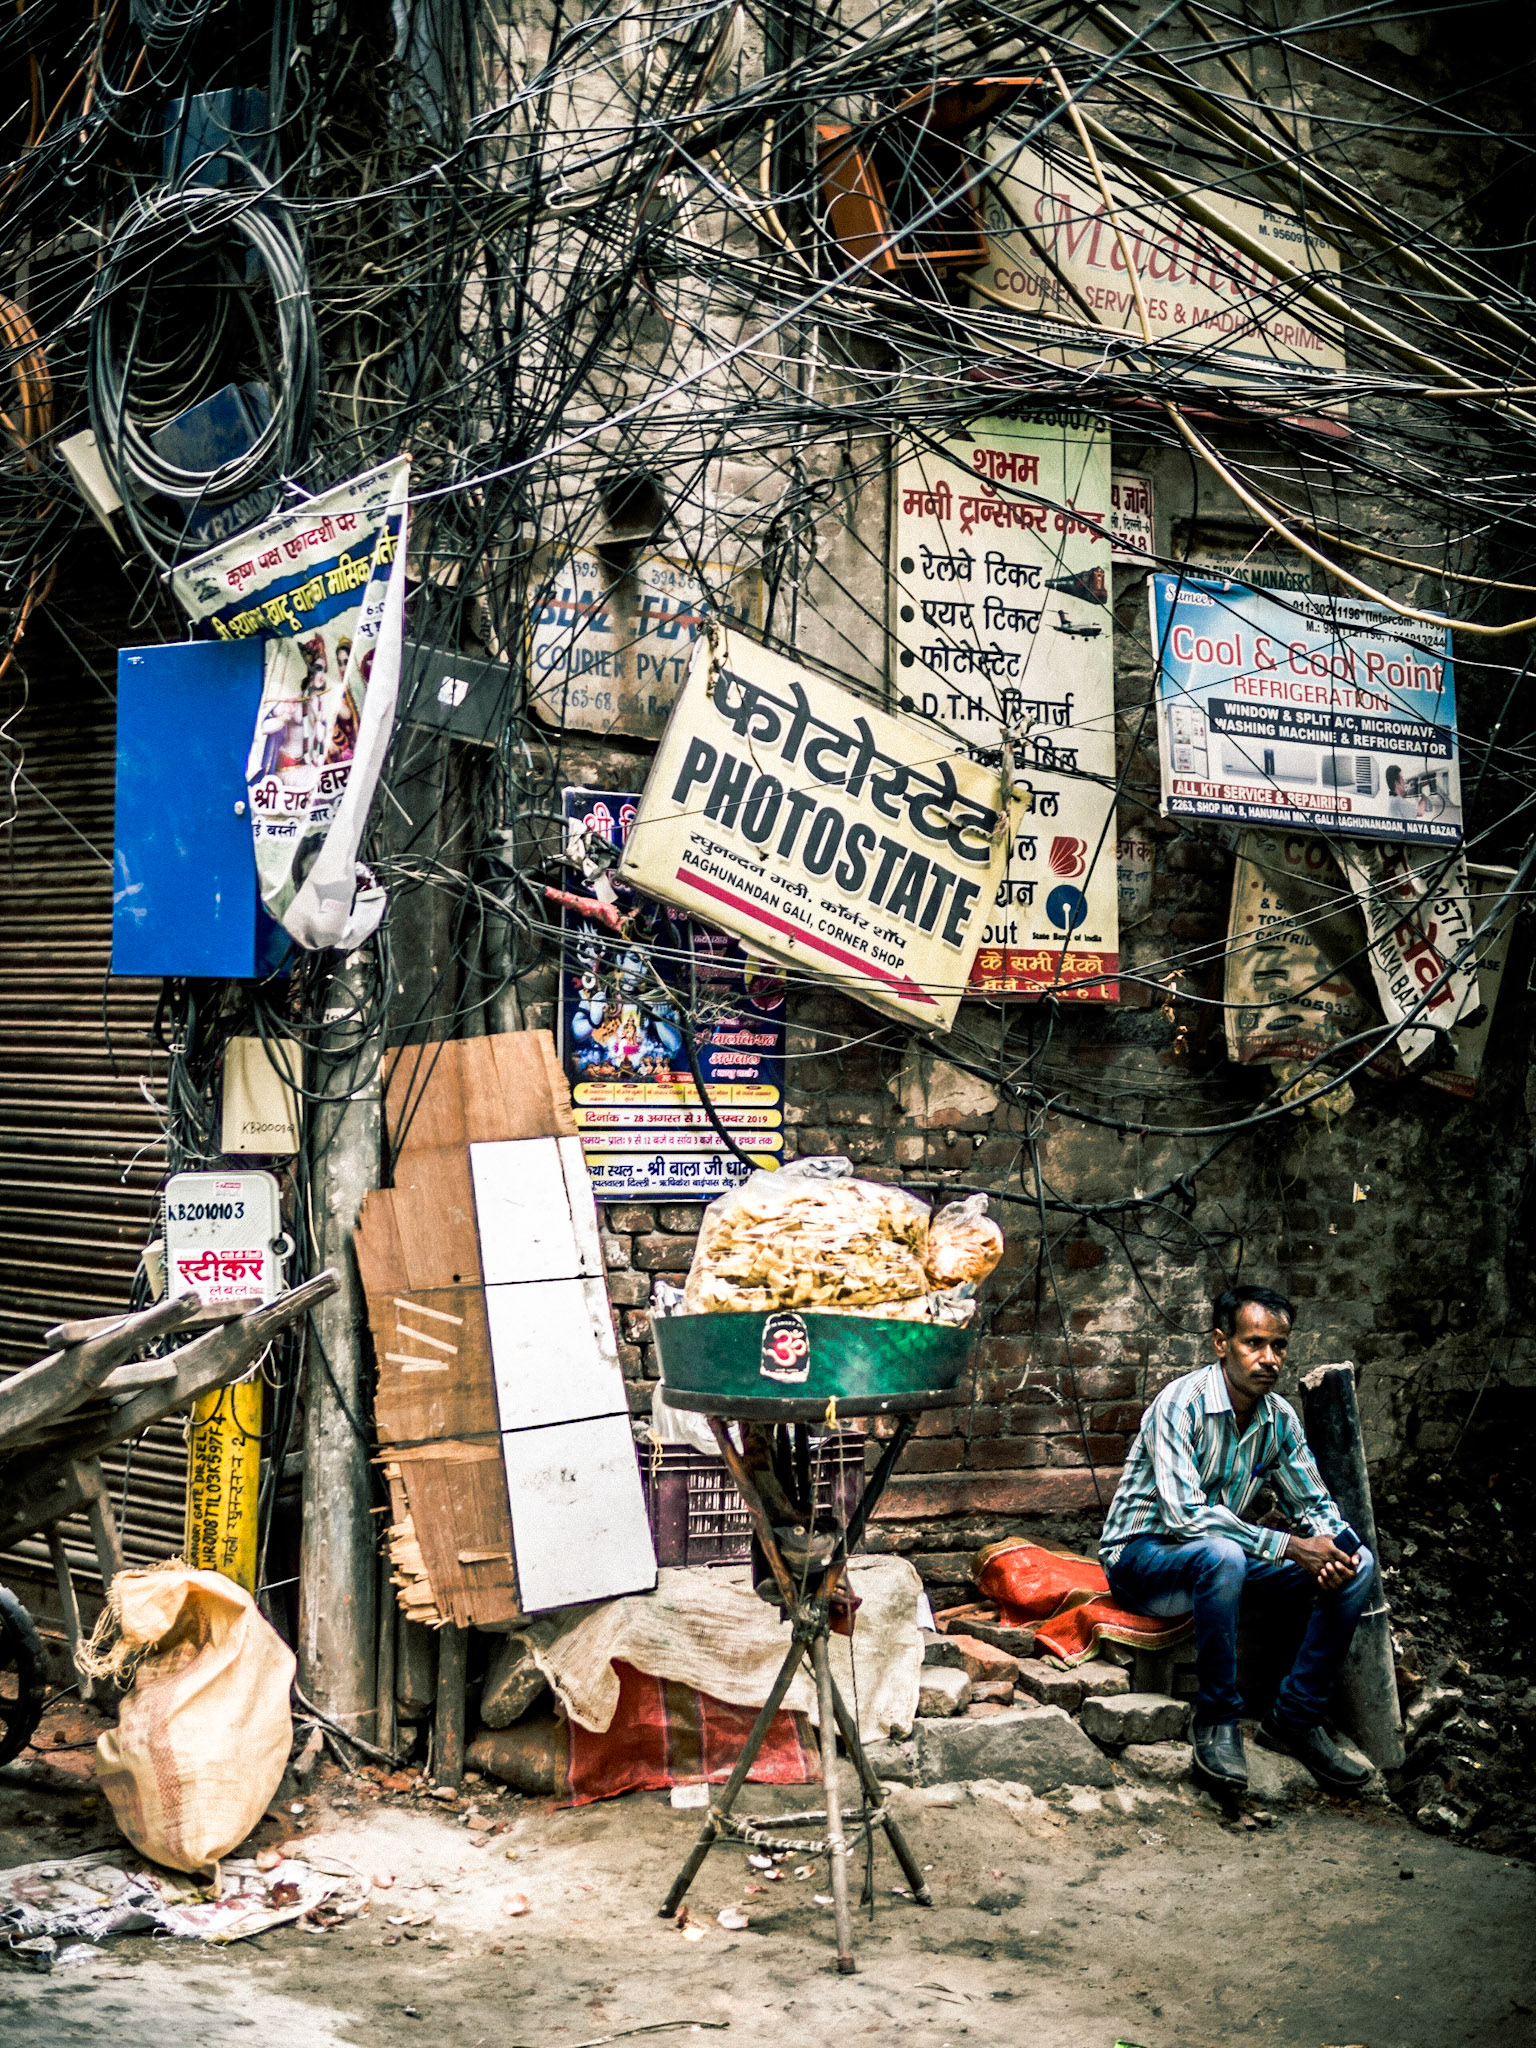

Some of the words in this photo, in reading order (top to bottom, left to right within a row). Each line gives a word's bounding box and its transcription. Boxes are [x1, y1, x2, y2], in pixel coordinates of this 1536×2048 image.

[1029, 192, 1297, 302] Madhu
[1173, 307, 1187, 325] &
[1273, 321, 1325, 352] PRIME
[972, 448, 1040, 498] शुभम
[902, 480, 953, 521] मनी
[335, 512, 358, 533] पर
[919, 543, 976, 583] रेलवे
[984, 550, 1043, 589] टिकट
[920, 600, 975, 629] एयर
[984, 595, 1043, 635] टिकट
[536, 642, 627, 679] COURIER
[637, 653, 685, 684] PVT
[920, 637, 1022, 678] फोटोस्टेट
[1171, 625, 1242, 667] Cool
[1254, 637, 1278, 671] &
[1288, 641, 1356, 682] Cool
[1366, 651, 1447, 693] Point
[922, 692, 990, 722] D.T.H.
[1224, 702, 1279, 721] WINDOW
[1283, 711, 1292, 723] &
[1296, 712, 1331, 727] SPLIT
[1233, 676, 1390, 713] REFRIGERATION
[1215, 717, 1276, 736] WASHING
[1279, 726, 1336, 744] MACHINE
[1341, 733, 1350, 745] &
[1353, 733, 1447, 757] REFRIGERATOR
[711, 667, 998, 863] फोटोस्टेट
[254, 780, 279, 811] श्री
[1176, 780, 1198, 796] ALL
[1201, 783, 1221, 798] KIT
[1224, 785, 1273, 803] SERVICE
[1276, 792, 1284, 804] &
[1287, 792, 1349, 811] REPAIRING
[1172, 799, 1196, 814] 2263,
[1197, 801, 1220, 813] SHOP
[1222, 803, 1238, 816] NO.
[1248, 806, 1291, 821] HANUMAN
[1314, 813, 1334, 826] GALI
[1407, 823, 1429, 835] NAYA
[1430, 825, 1458, 838] BAZAR
[671, 735, 981, 949] PHOTOSTATE
[682, 849, 780, 909] RAGHUNANDAN
[782, 902, 815, 931] GALI,
[818, 918, 869, 954] CORNER
[870, 944, 906, 970] SHOP
[689, 830, 766, 879] रघुनन्दन
[820, 894, 872, 932] कॉर्नर
[872, 917, 908, 950] शॉप
[979, 951, 1002, 971] के
[1010, 954, 1054, 973] सभी
[585, 1110, 620, 1123] दिनांक
[647, 1112, 681, 1124] अगस्त
[684, 1111, 693, 1123] से
[747, 1115, 768, 1123] 2019
[607, 1165, 634, 1178] स्थल
[648, 1155, 666, 1178] श्री
[669, 1160, 701, 1177] बाला
[705, 1155, 723, 1177] जी
[168, 1202, 246, 1222] KB2010103
[177, 1250, 264, 1285] स्टीकर
